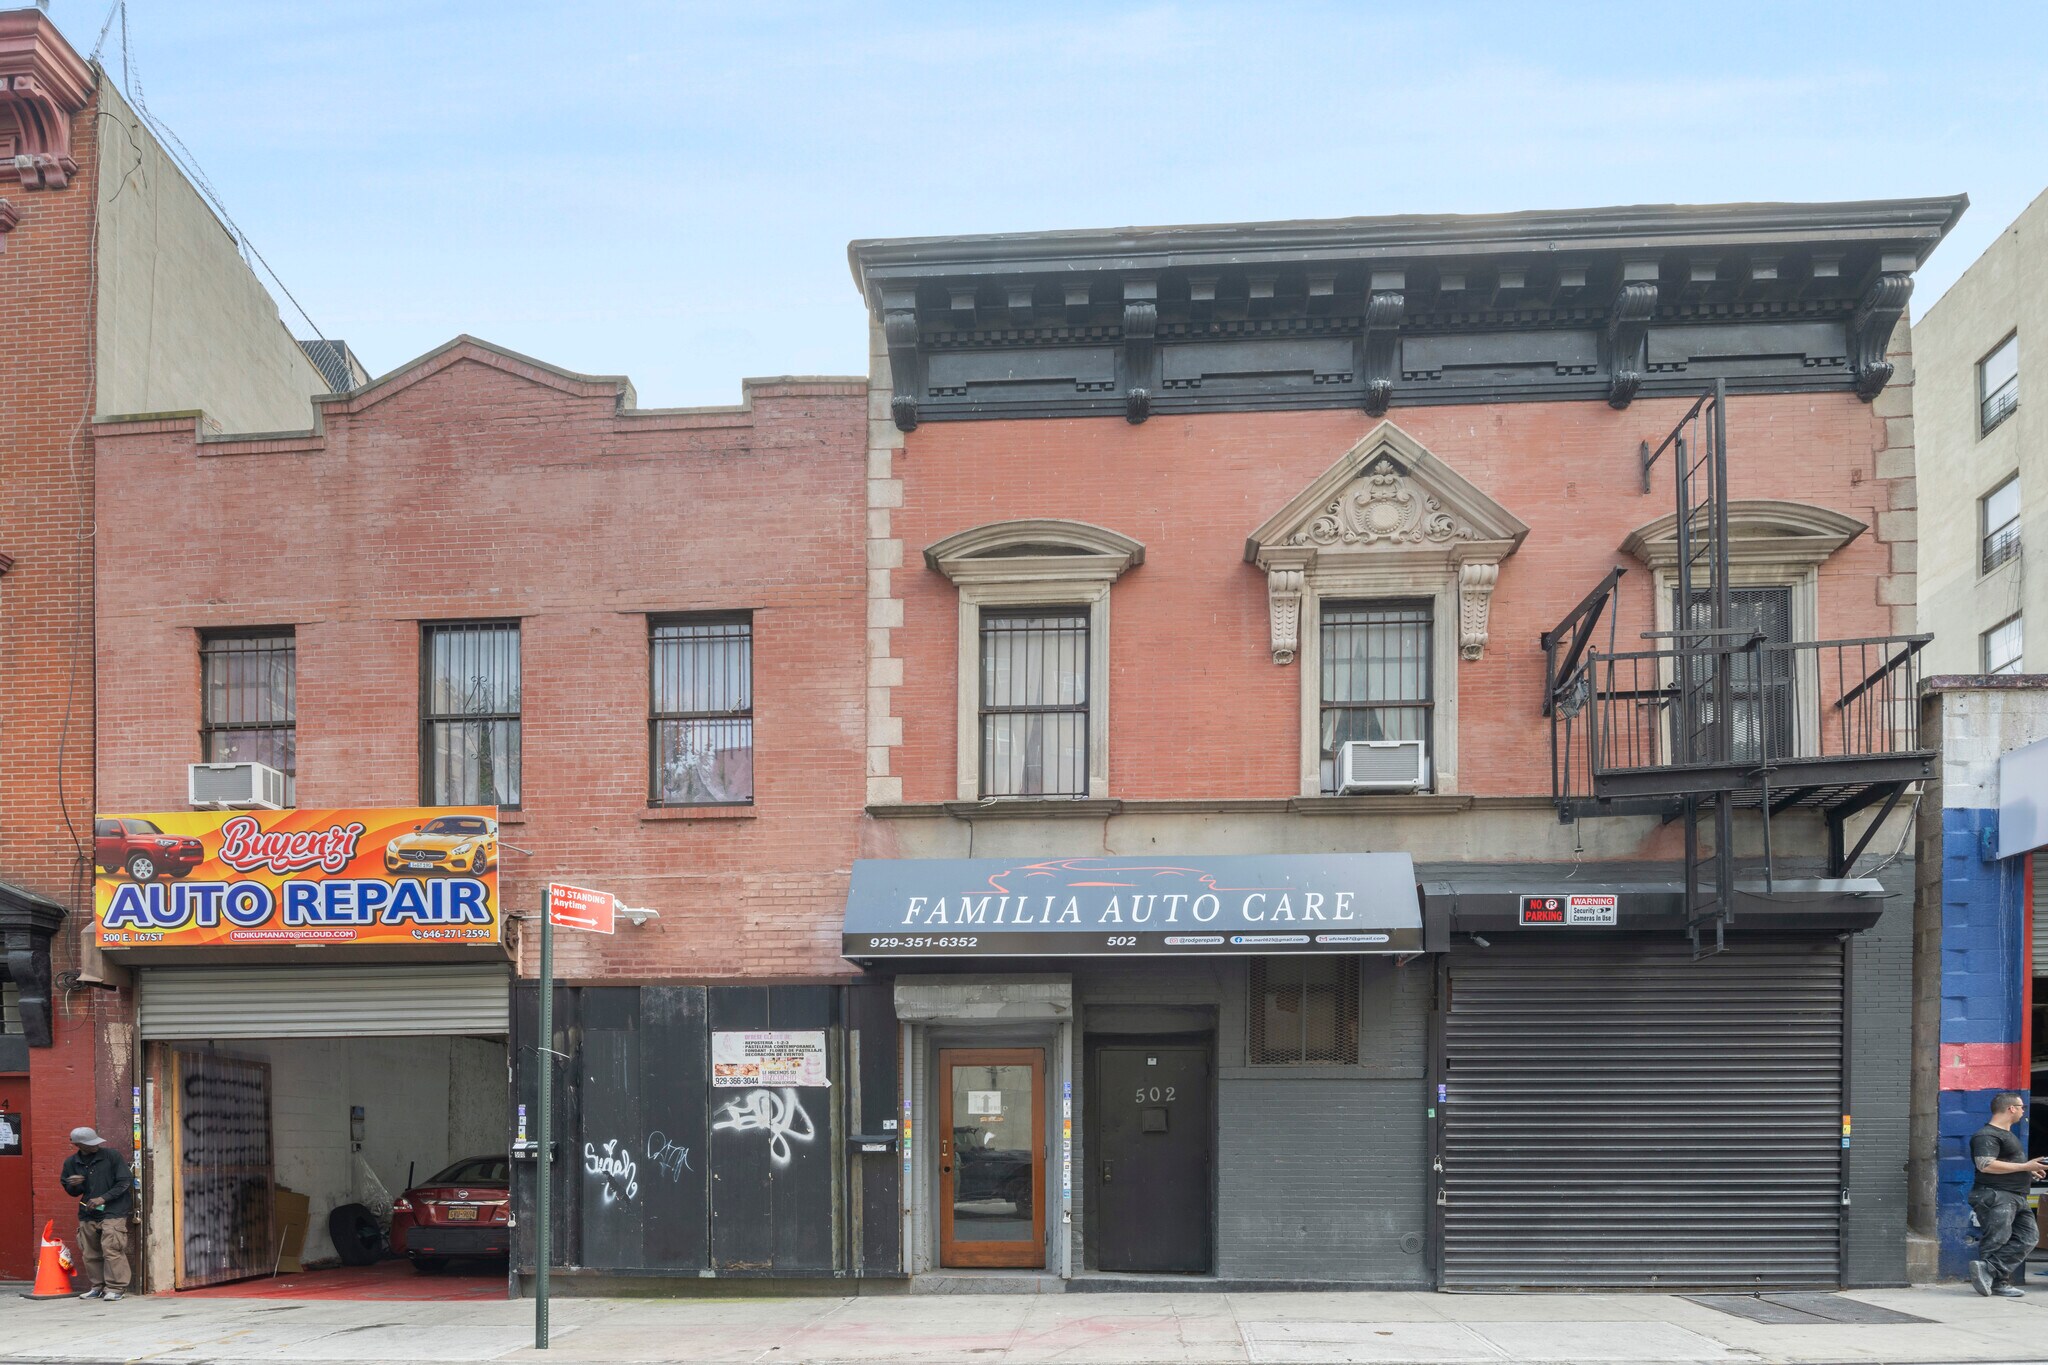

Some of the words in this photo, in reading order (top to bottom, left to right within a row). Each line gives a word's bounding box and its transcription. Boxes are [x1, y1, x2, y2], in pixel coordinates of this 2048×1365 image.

[553, 888, 565, 897] NO
[567, 890, 606, 905] STANDING
[103, 880, 275, 928] AUTO
[282, 878, 493, 926] REPAIR
[553, 898, 587, 910] Anytime
[900, 894, 1083, 925] FAMILIA
[1097, 894, 1222, 923] AUTO
[1242, 891, 1357, 921] CARE
[1530, 899, 1543, 910] NO
[1525, 911, 1563, 921] PARKING
[103, 933, 121, 942] 500
[122, 933, 132, 942] E.
[134, 933, 164, 942] 167ST
[233, 931, 354, 940] NDIKUMANA70@ICLOUD.COM
[422, 929, 491, 939] 646-271-2594
[869, 936, 978, 948] 929-351-6352
[1106, 935, 1137, 947] 502
[1179, 937, 1221, 945] @rodgerepairs
[1136, 1086, 1176, 1103] 502
